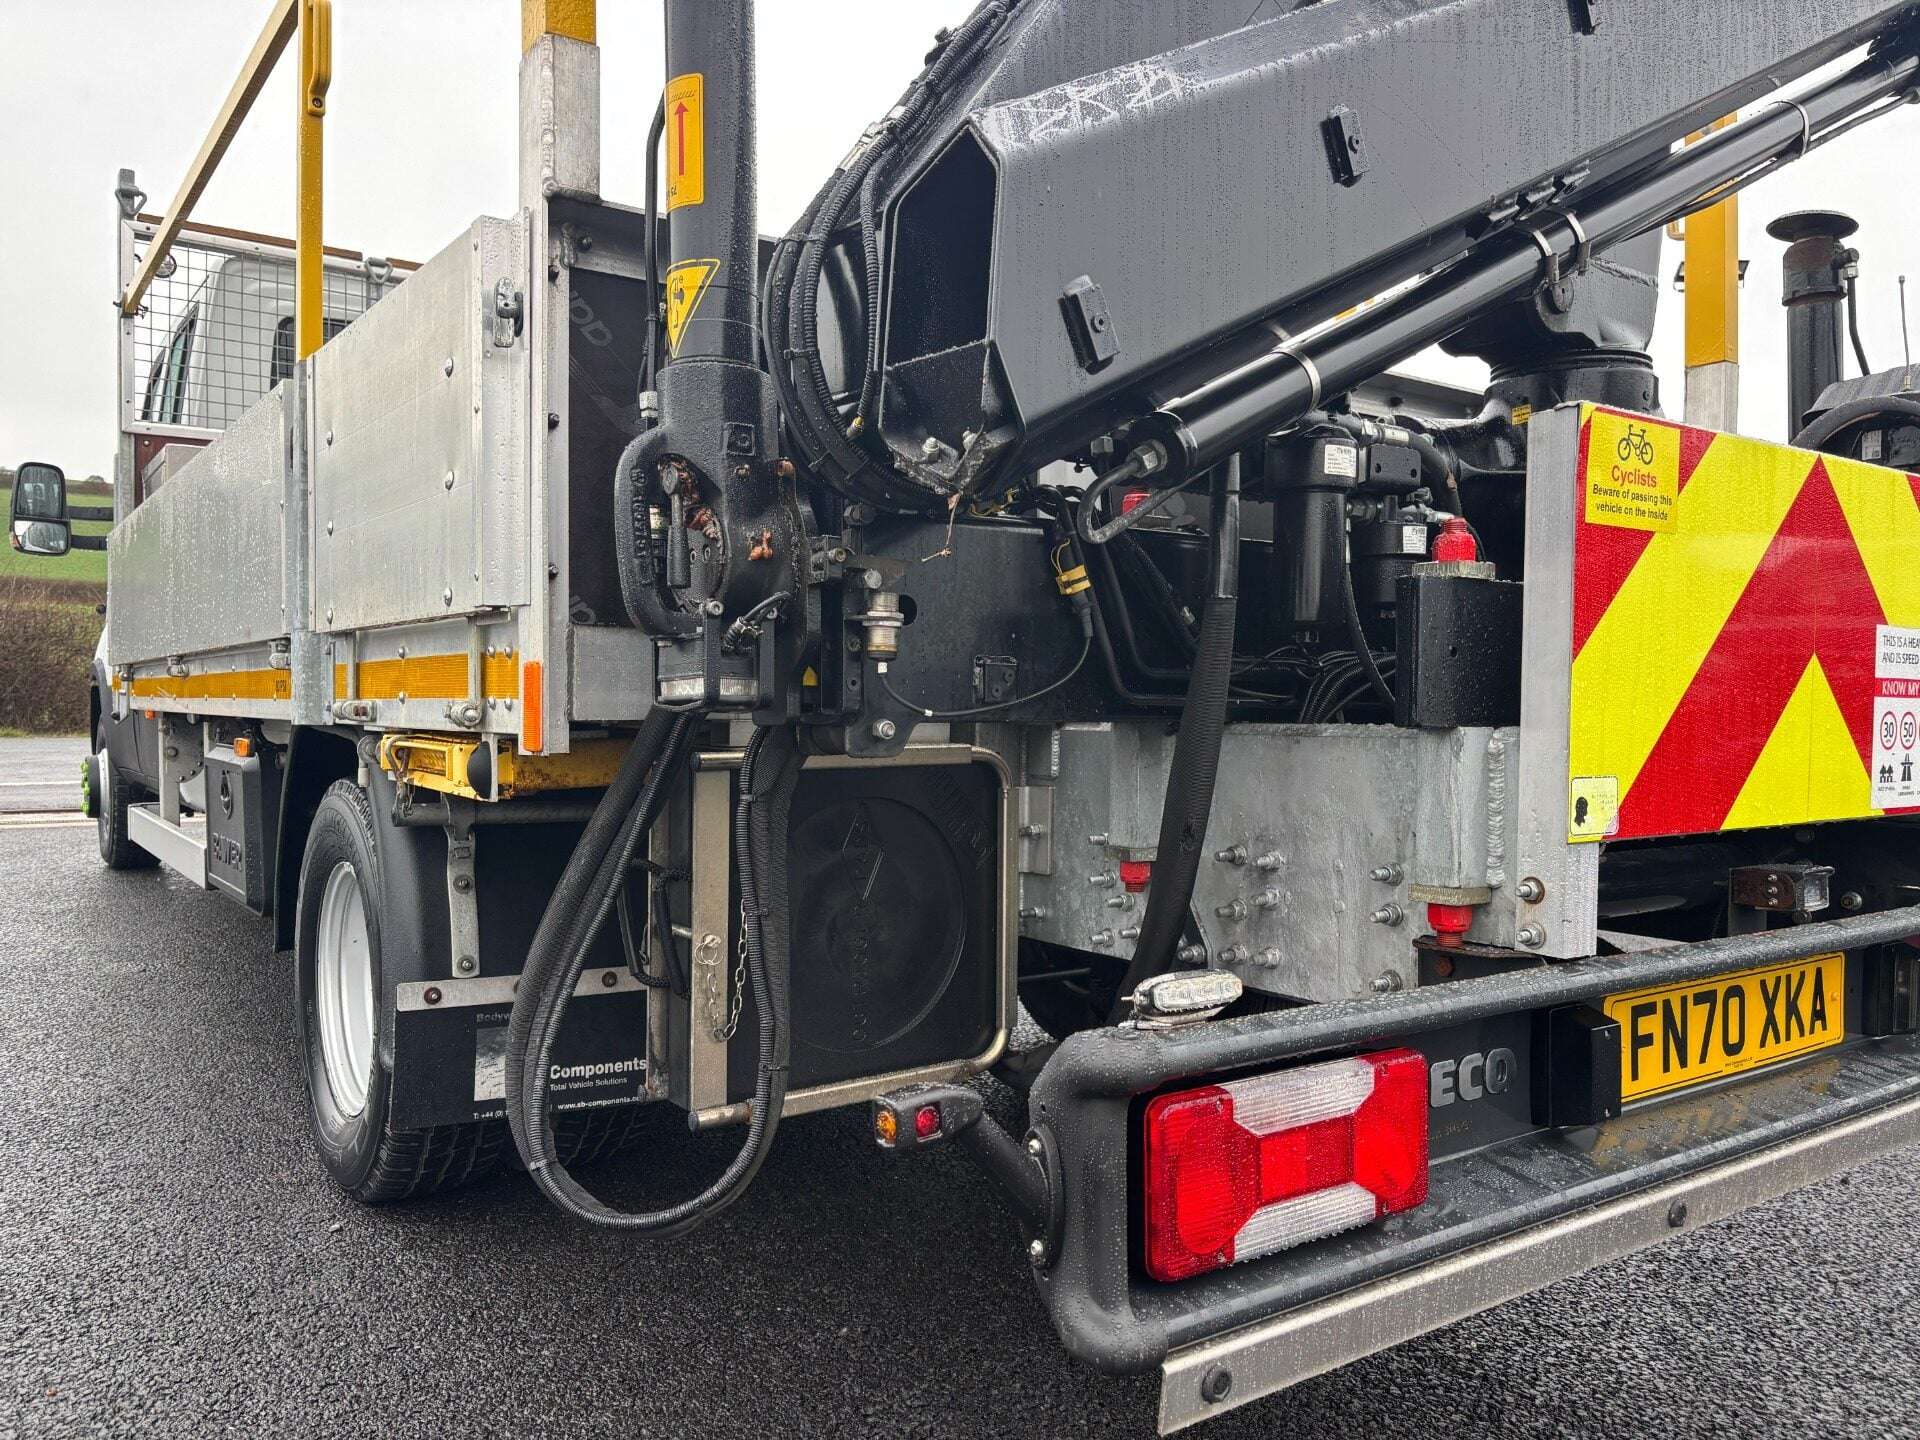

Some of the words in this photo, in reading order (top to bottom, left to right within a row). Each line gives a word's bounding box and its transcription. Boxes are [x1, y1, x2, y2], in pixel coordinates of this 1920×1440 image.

[1612, 465, 1657, 487] Cyclists
[1593, 483, 1620, 498] Beware
[1622, 489, 1630, 499] of
[1631, 491, 1658, 506] passing
[1660, 494, 1672, 506] this
[1596, 502, 1622, 514] vehicle
[1624, 506, 1633, 515] on
[1635, 508, 1646, 518] the
[1647, 509, 1668, 520] inside
[1883, 635, 1896, 647] THIS
[1896, 636, 1902, 648] IS
[1903, 637, 1908, 649] A
[1908, 637, 1920, 649] HEA
[1882, 652, 1895, 664] AND
[1895, 652, 1902, 664] IS
[1902, 653, 1919, 665] SPEED
[1882, 680, 1907, 696] KNOW
[1907, 681, 1920, 697] MY
[1883, 721, 1894, 738] 30
[1903, 721, 1914, 738] 50
[1630, 984, 1746, 1082] FN70
[1759, 967, 1828, 1050] XKA
[550, 1056, 647, 1080] Components
[550, 1083, 567, 1091] Total
[568, 1080, 594, 1090] Vehicle
[595, 1077, 628, 1087] Solutions
[1430, 1047, 1517, 1108] ECO
